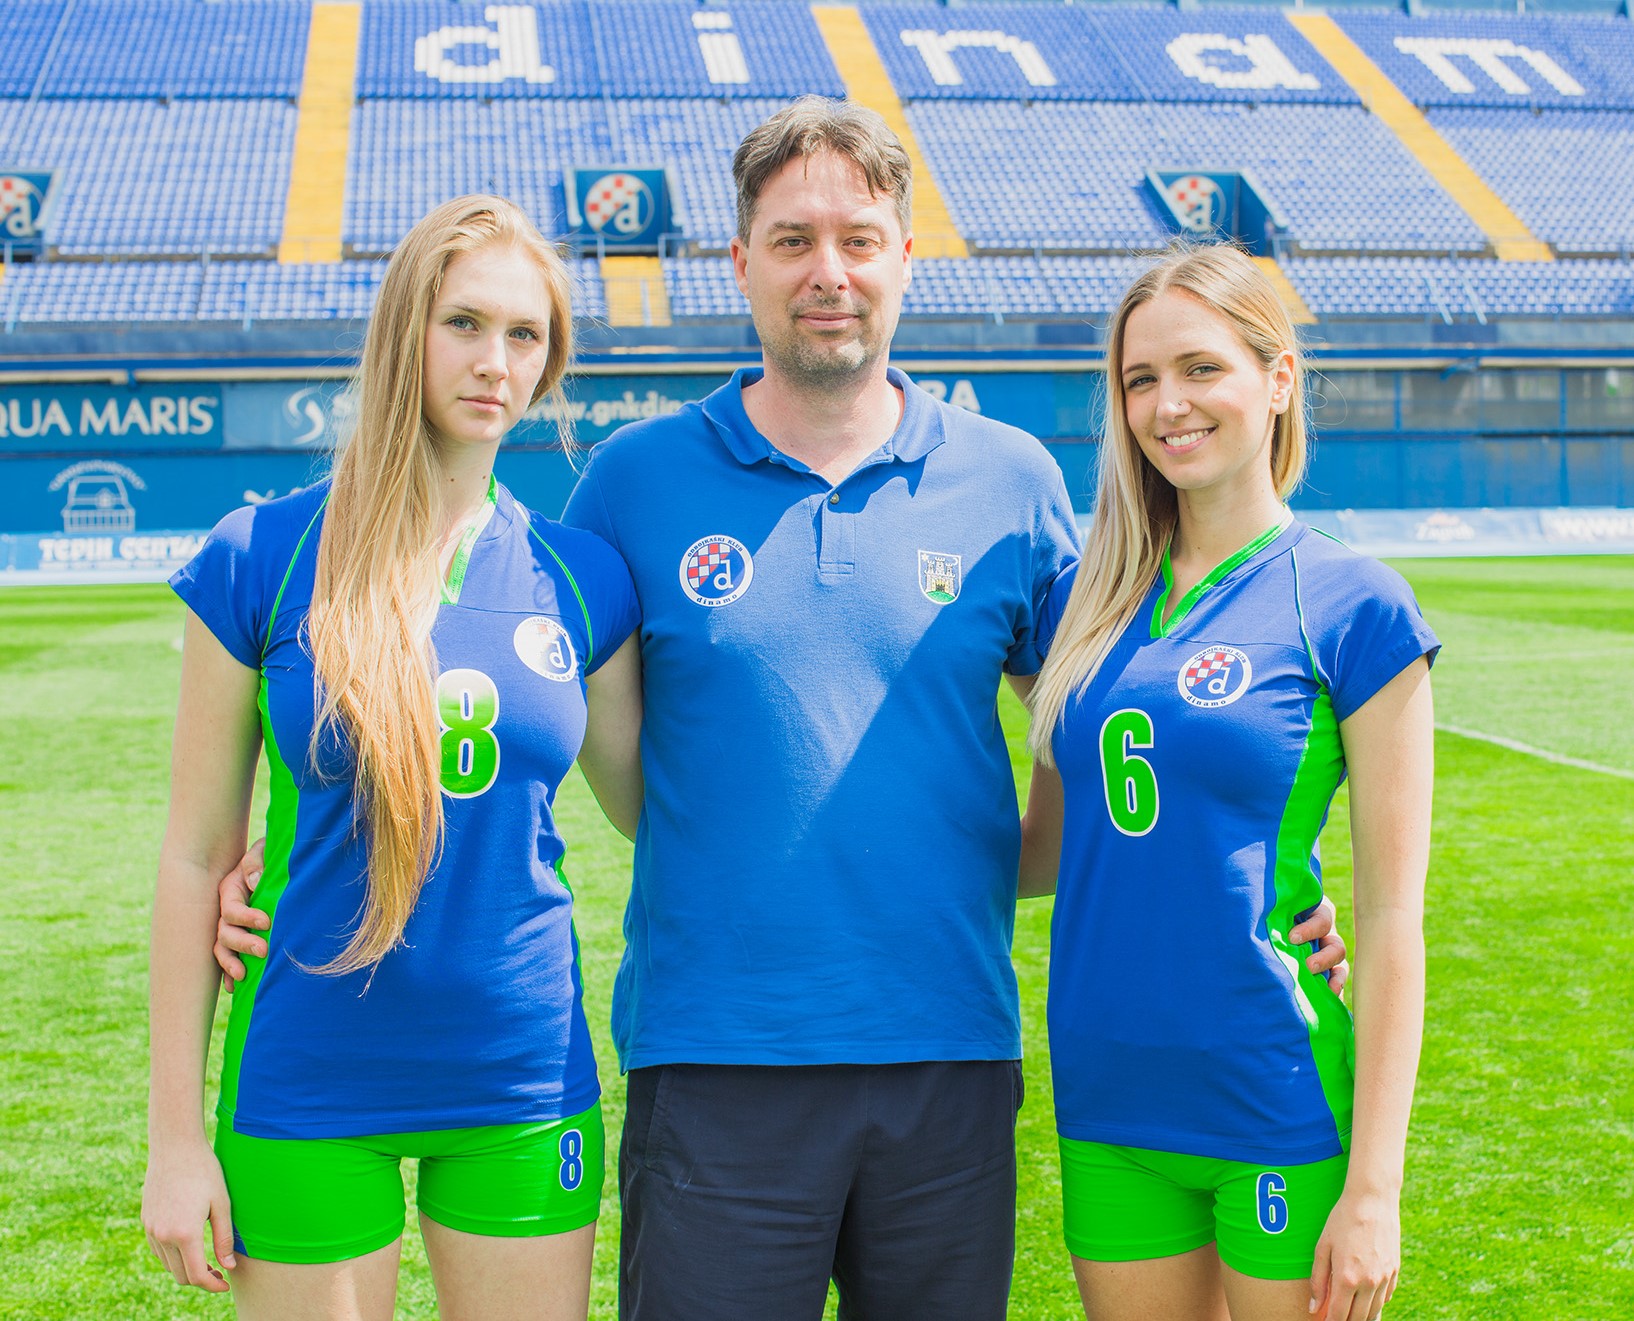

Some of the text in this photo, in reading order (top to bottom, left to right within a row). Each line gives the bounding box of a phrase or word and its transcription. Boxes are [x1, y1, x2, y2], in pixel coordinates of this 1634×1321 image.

[79, 396, 214, 436] MARIS
[696, 594, 738, 606] dinamo
[1186, 695, 1226, 707] dinamo
[436, 669, 500, 799] 8
[1099, 708, 1160, 837] 6
[559, 1129, 583, 1191] 8
[1256, 1172, 1288, 1234] 6
